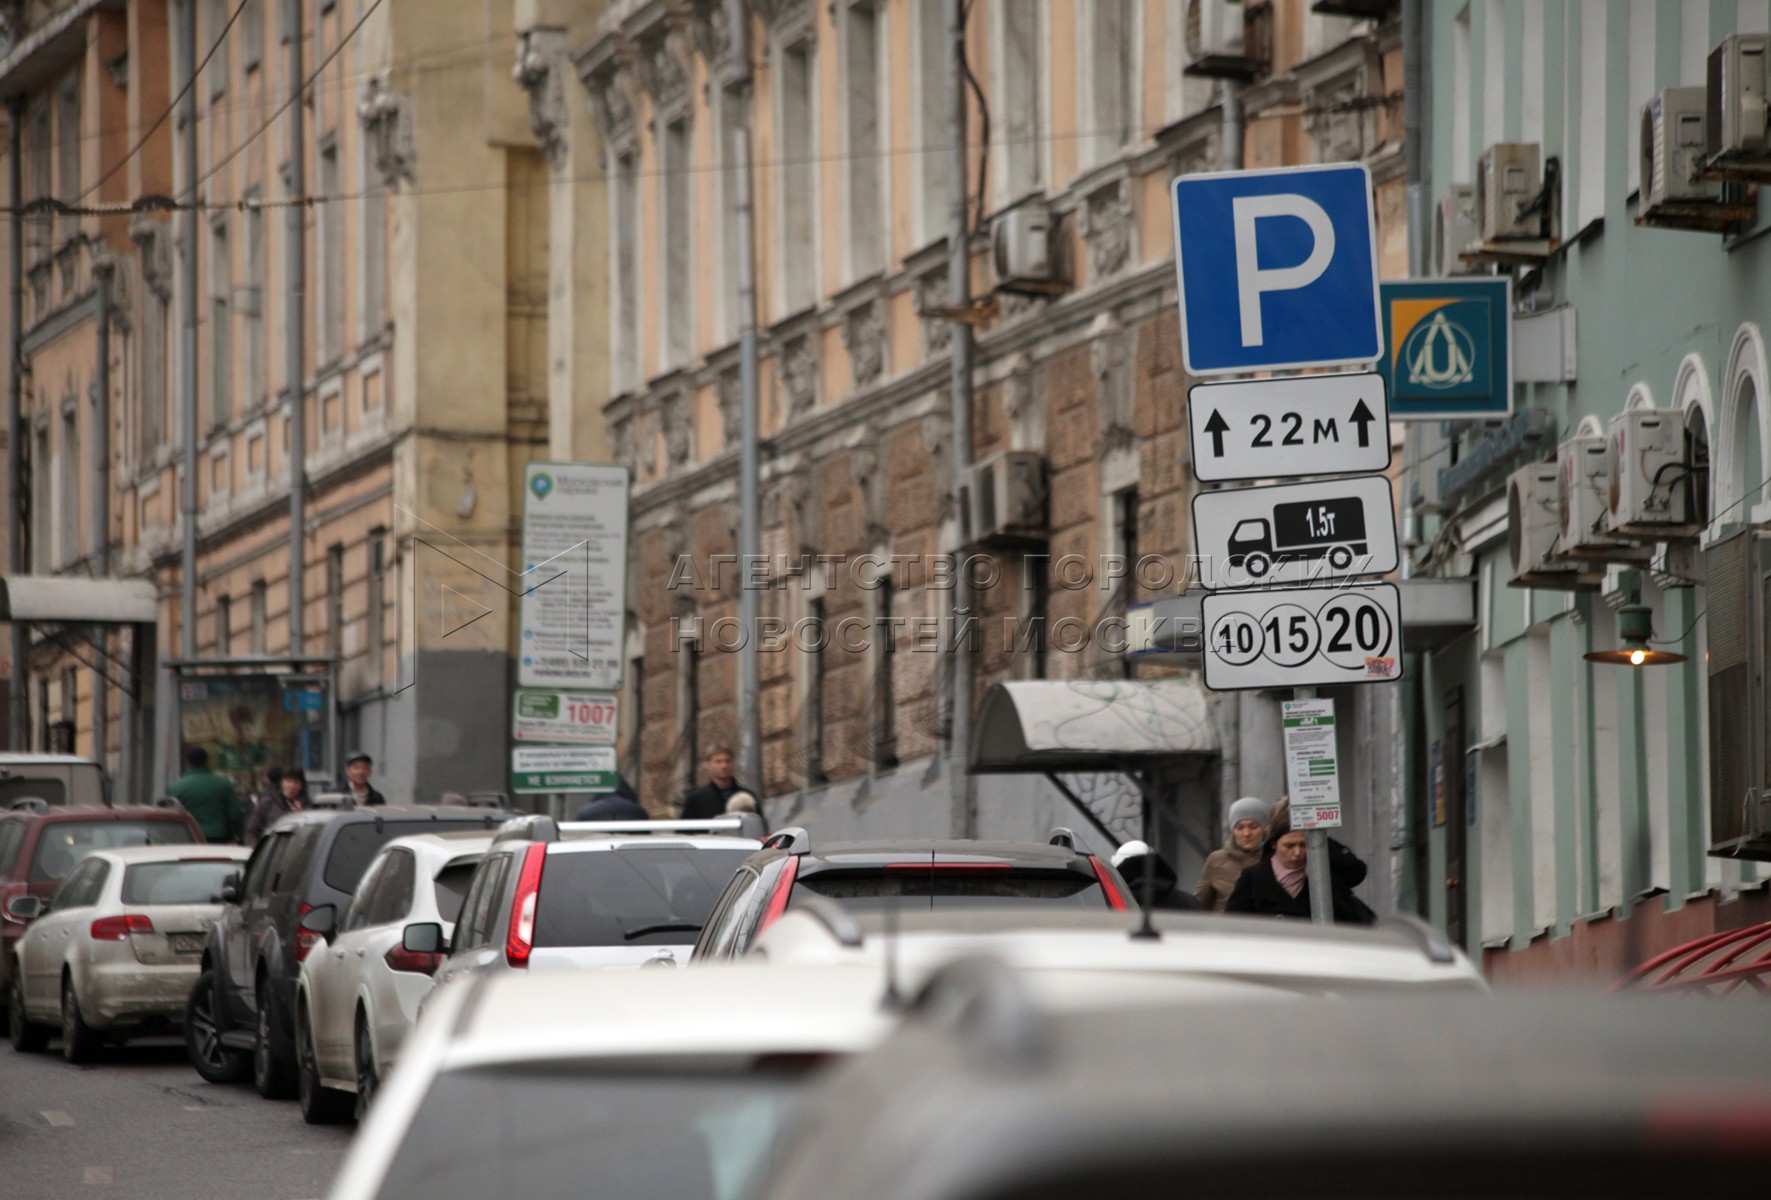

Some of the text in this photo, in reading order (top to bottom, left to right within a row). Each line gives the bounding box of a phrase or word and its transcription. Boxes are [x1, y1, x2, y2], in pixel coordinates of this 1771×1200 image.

[1232, 193, 1336, 347] P
[1219, 605, 1380, 654] 10 15 20
[567, 704, 616, 724] 1007
[1316, 810, 1339, 821] 5007
